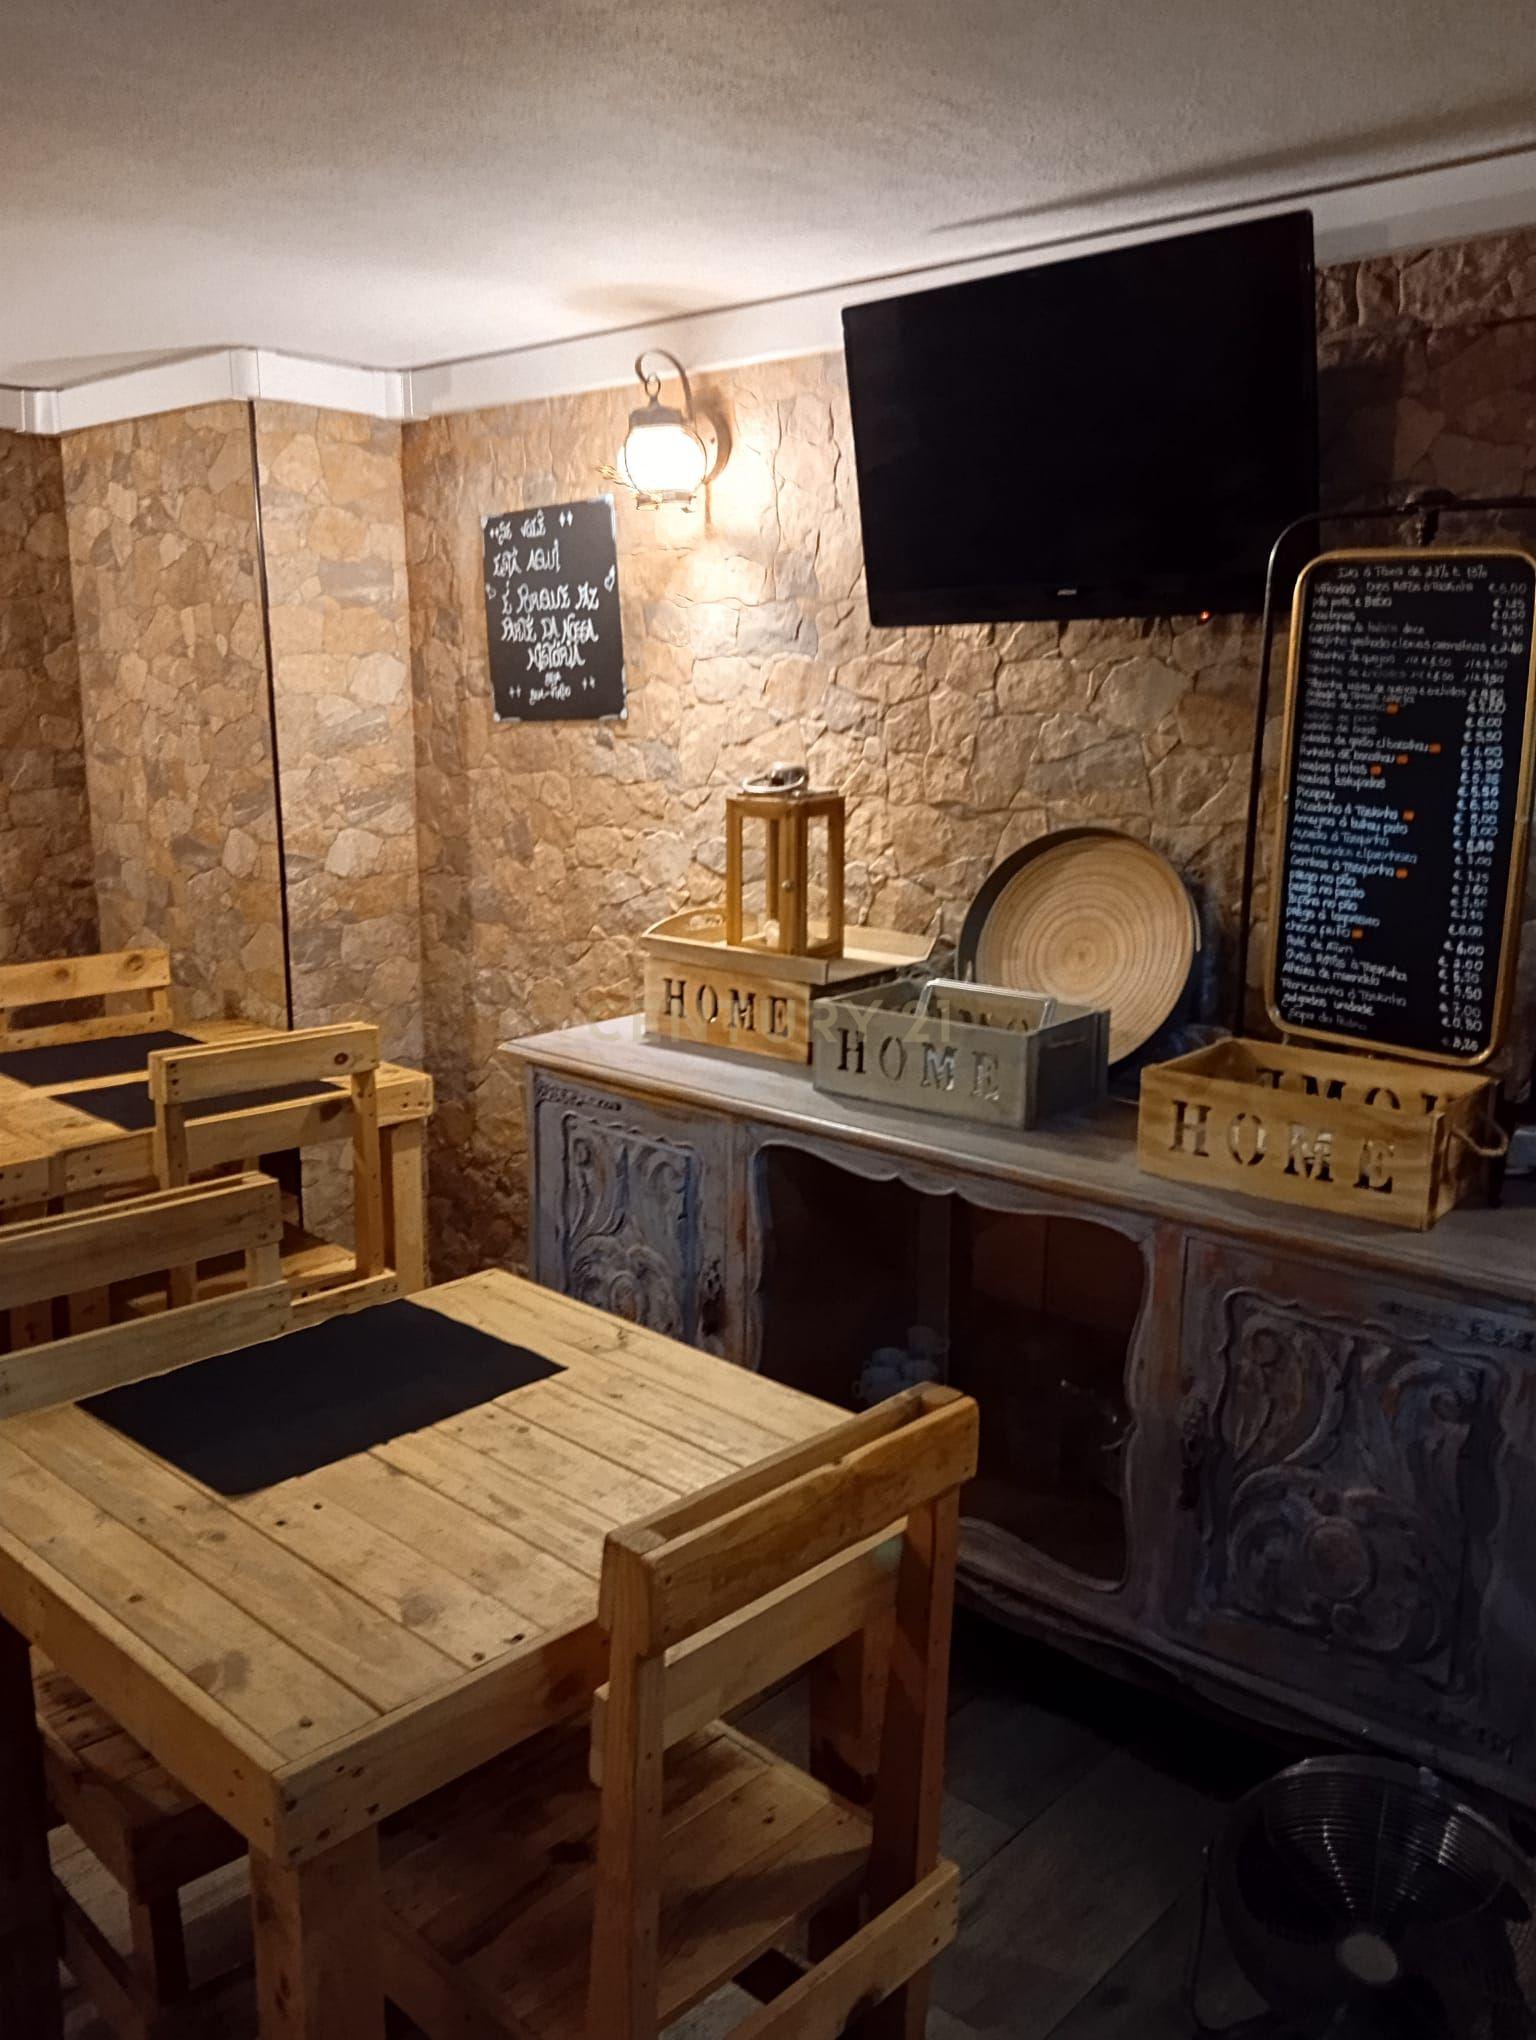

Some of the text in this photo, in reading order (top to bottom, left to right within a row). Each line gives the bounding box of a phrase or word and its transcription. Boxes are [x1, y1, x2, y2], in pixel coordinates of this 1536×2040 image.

[662, 977, 790, 1038] HOME
[836, 1027, 1000, 1101] HOME
[1168, 1099, 1396, 1194] HOME
